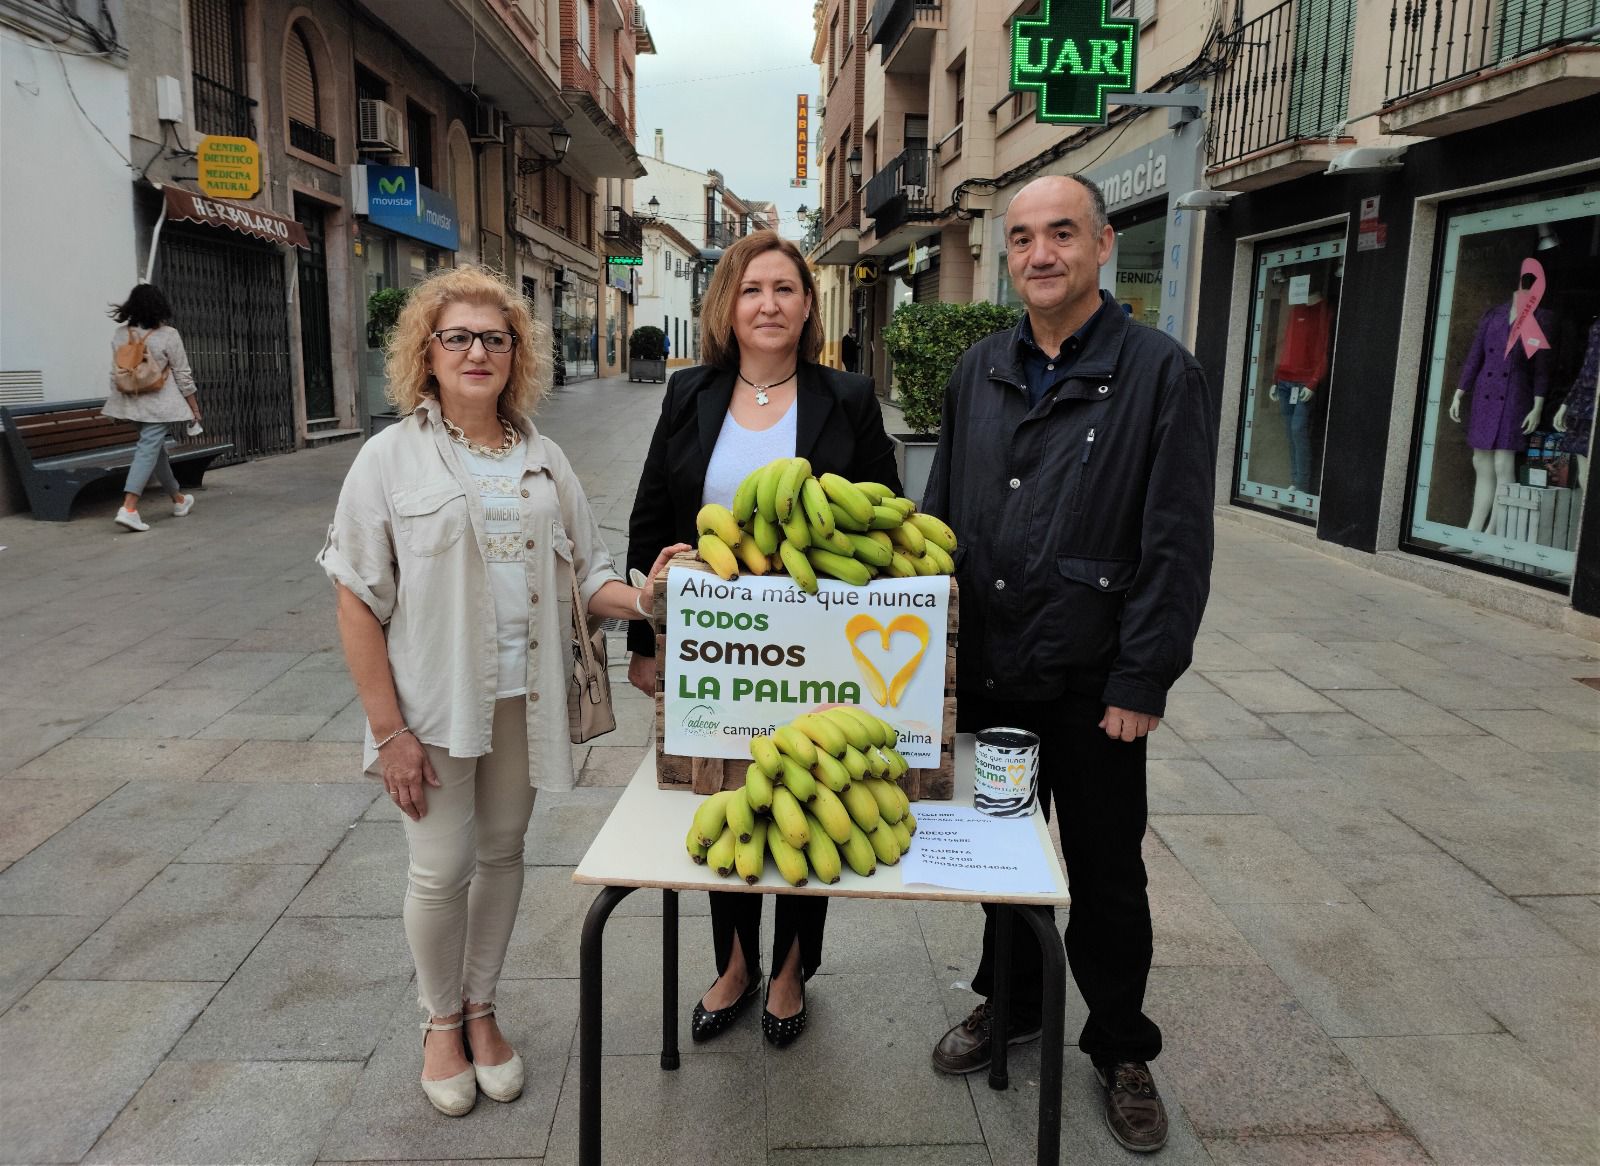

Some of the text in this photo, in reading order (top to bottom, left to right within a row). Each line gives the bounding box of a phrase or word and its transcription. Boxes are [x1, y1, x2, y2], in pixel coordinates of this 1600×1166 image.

[797, 95, 807, 177] TABACOS
[209, 142, 247, 152] CENTRO
[203, 153, 253, 165] DIETETICO
[205, 169, 251, 180] MEDICINA
[207, 181, 250, 191] NATURAL
[372, 197, 413, 206] movistar
[191, 196, 289, 238] HERBOLARIO
[426, 209, 452, 230] movistar
[485, 507, 520, 521] MOMENTS
[679, 577, 937, 611] Ahora más que nunca
[680, 608, 769, 631] TODOS
[679, 639, 806, 667] SOMOS
[679, 675, 861, 704] LA PALMA
[687, 715, 720, 730] adecov
